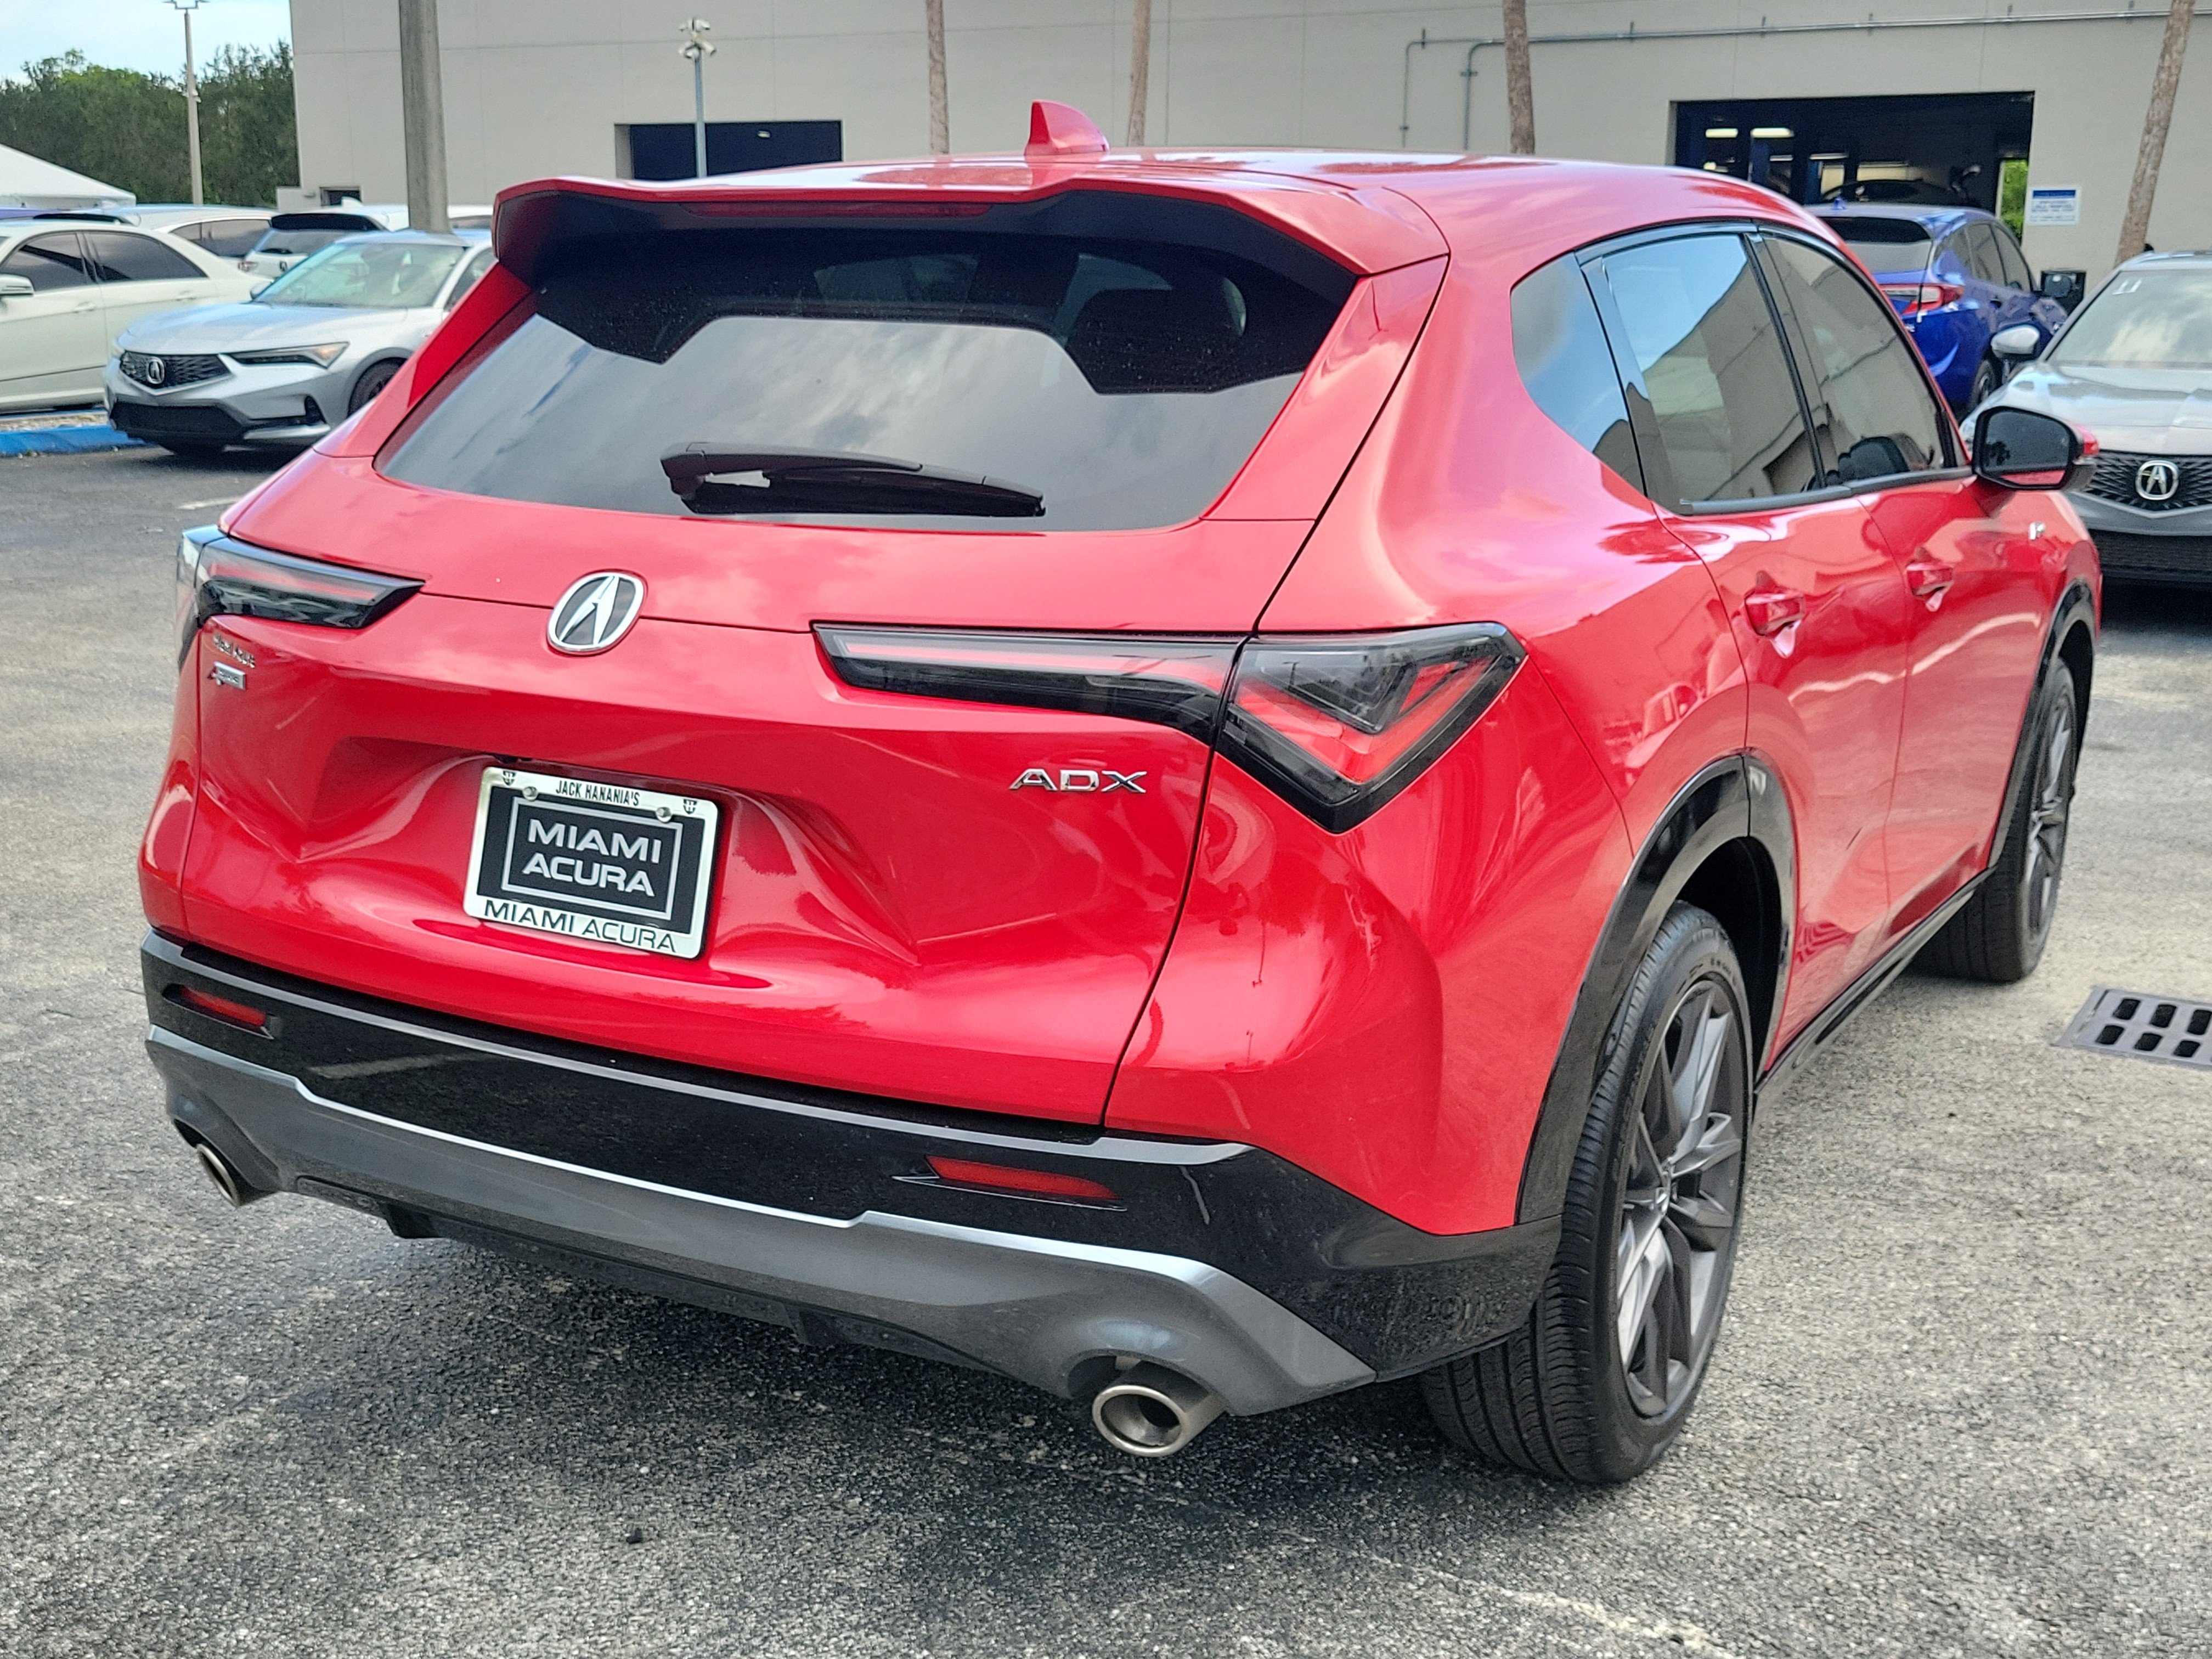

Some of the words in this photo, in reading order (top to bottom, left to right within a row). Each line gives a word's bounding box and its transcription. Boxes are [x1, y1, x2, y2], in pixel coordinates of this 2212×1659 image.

[555, 780, 582, 798] JACK
[585, 784, 640, 806] HANANIA'S
[1008, 768, 1148, 793] ADX
[527, 819, 662, 864] MIAMI
[522, 853, 654, 897] ACURA
[484, 900, 575, 933] MIAMI
[582, 919, 676, 952] ACURA
